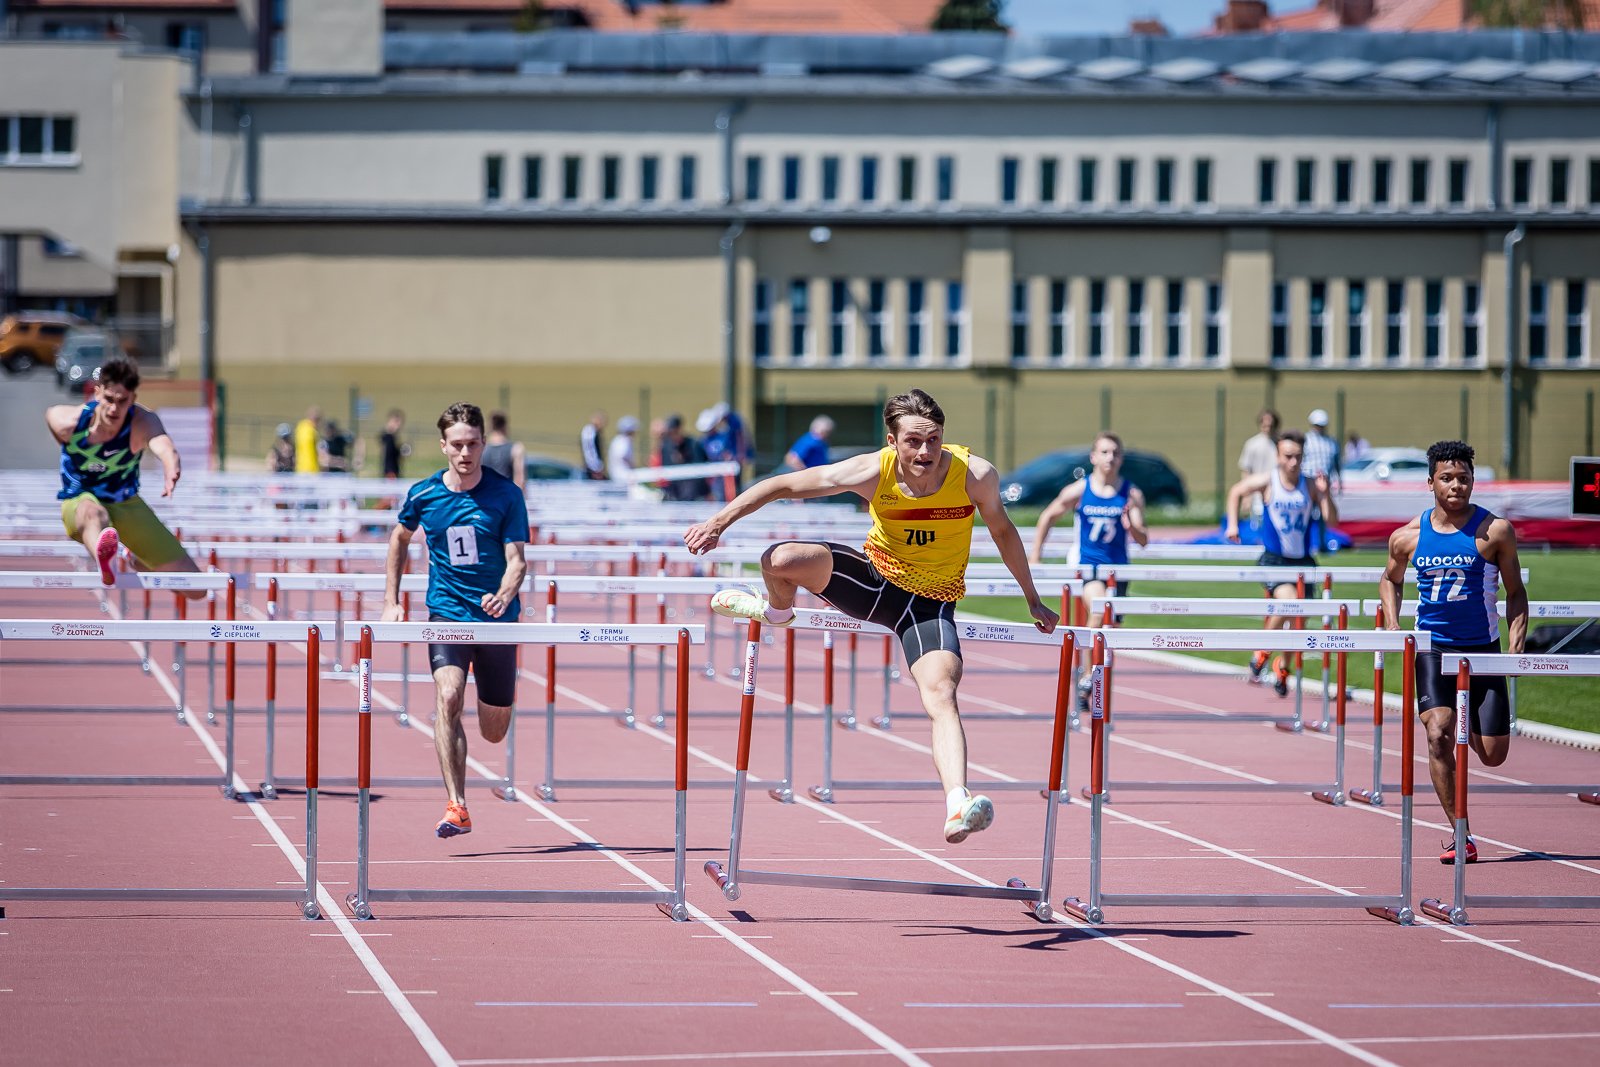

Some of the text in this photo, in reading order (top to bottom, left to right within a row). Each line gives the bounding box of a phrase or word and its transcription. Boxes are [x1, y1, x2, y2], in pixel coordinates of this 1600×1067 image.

[1280, 511, 1307, 535] 34
[454, 536, 469, 557] 1
[904, 528, 936, 546] 701
[1426, 568, 1468, 602] 72
[824, 621, 862, 630] ZŁOTNICZA
[987, 626, 1009, 634] TERMY
[747, 655, 755, 686] polanik
[362, 672, 370, 703] polanik
[1094, 679, 1103, 709] polanik
